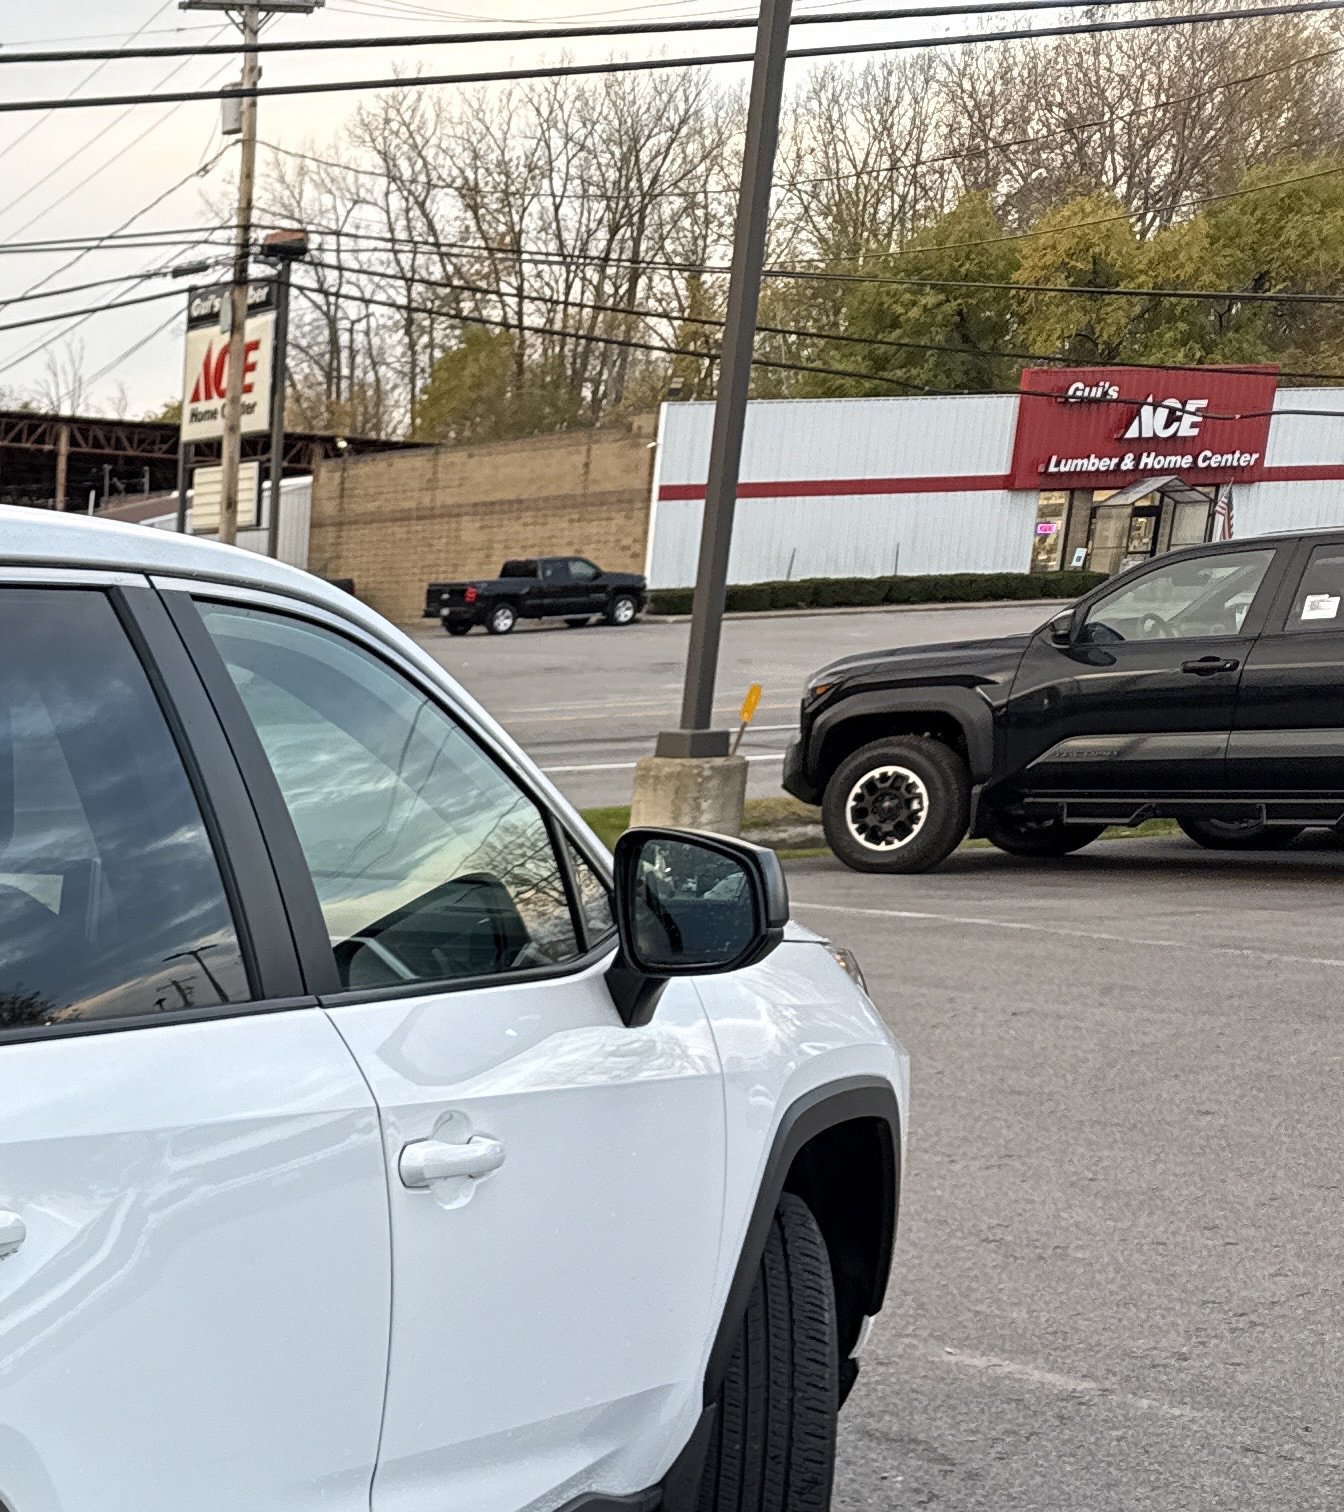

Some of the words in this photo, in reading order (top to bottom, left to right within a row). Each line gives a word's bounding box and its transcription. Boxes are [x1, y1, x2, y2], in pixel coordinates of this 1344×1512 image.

[190, 338, 261, 403] ACE
[1067, 381, 1119, 402] Gui's
[189, 407, 218, 423] Home
[1123, 393, 1209, 439] ACE
[1048, 453, 1118, 473] Lumber
[1120, 452, 1135, 470] &
[1139, 451, 1192, 470] Home
[1197, 449, 1260, 468] Center
